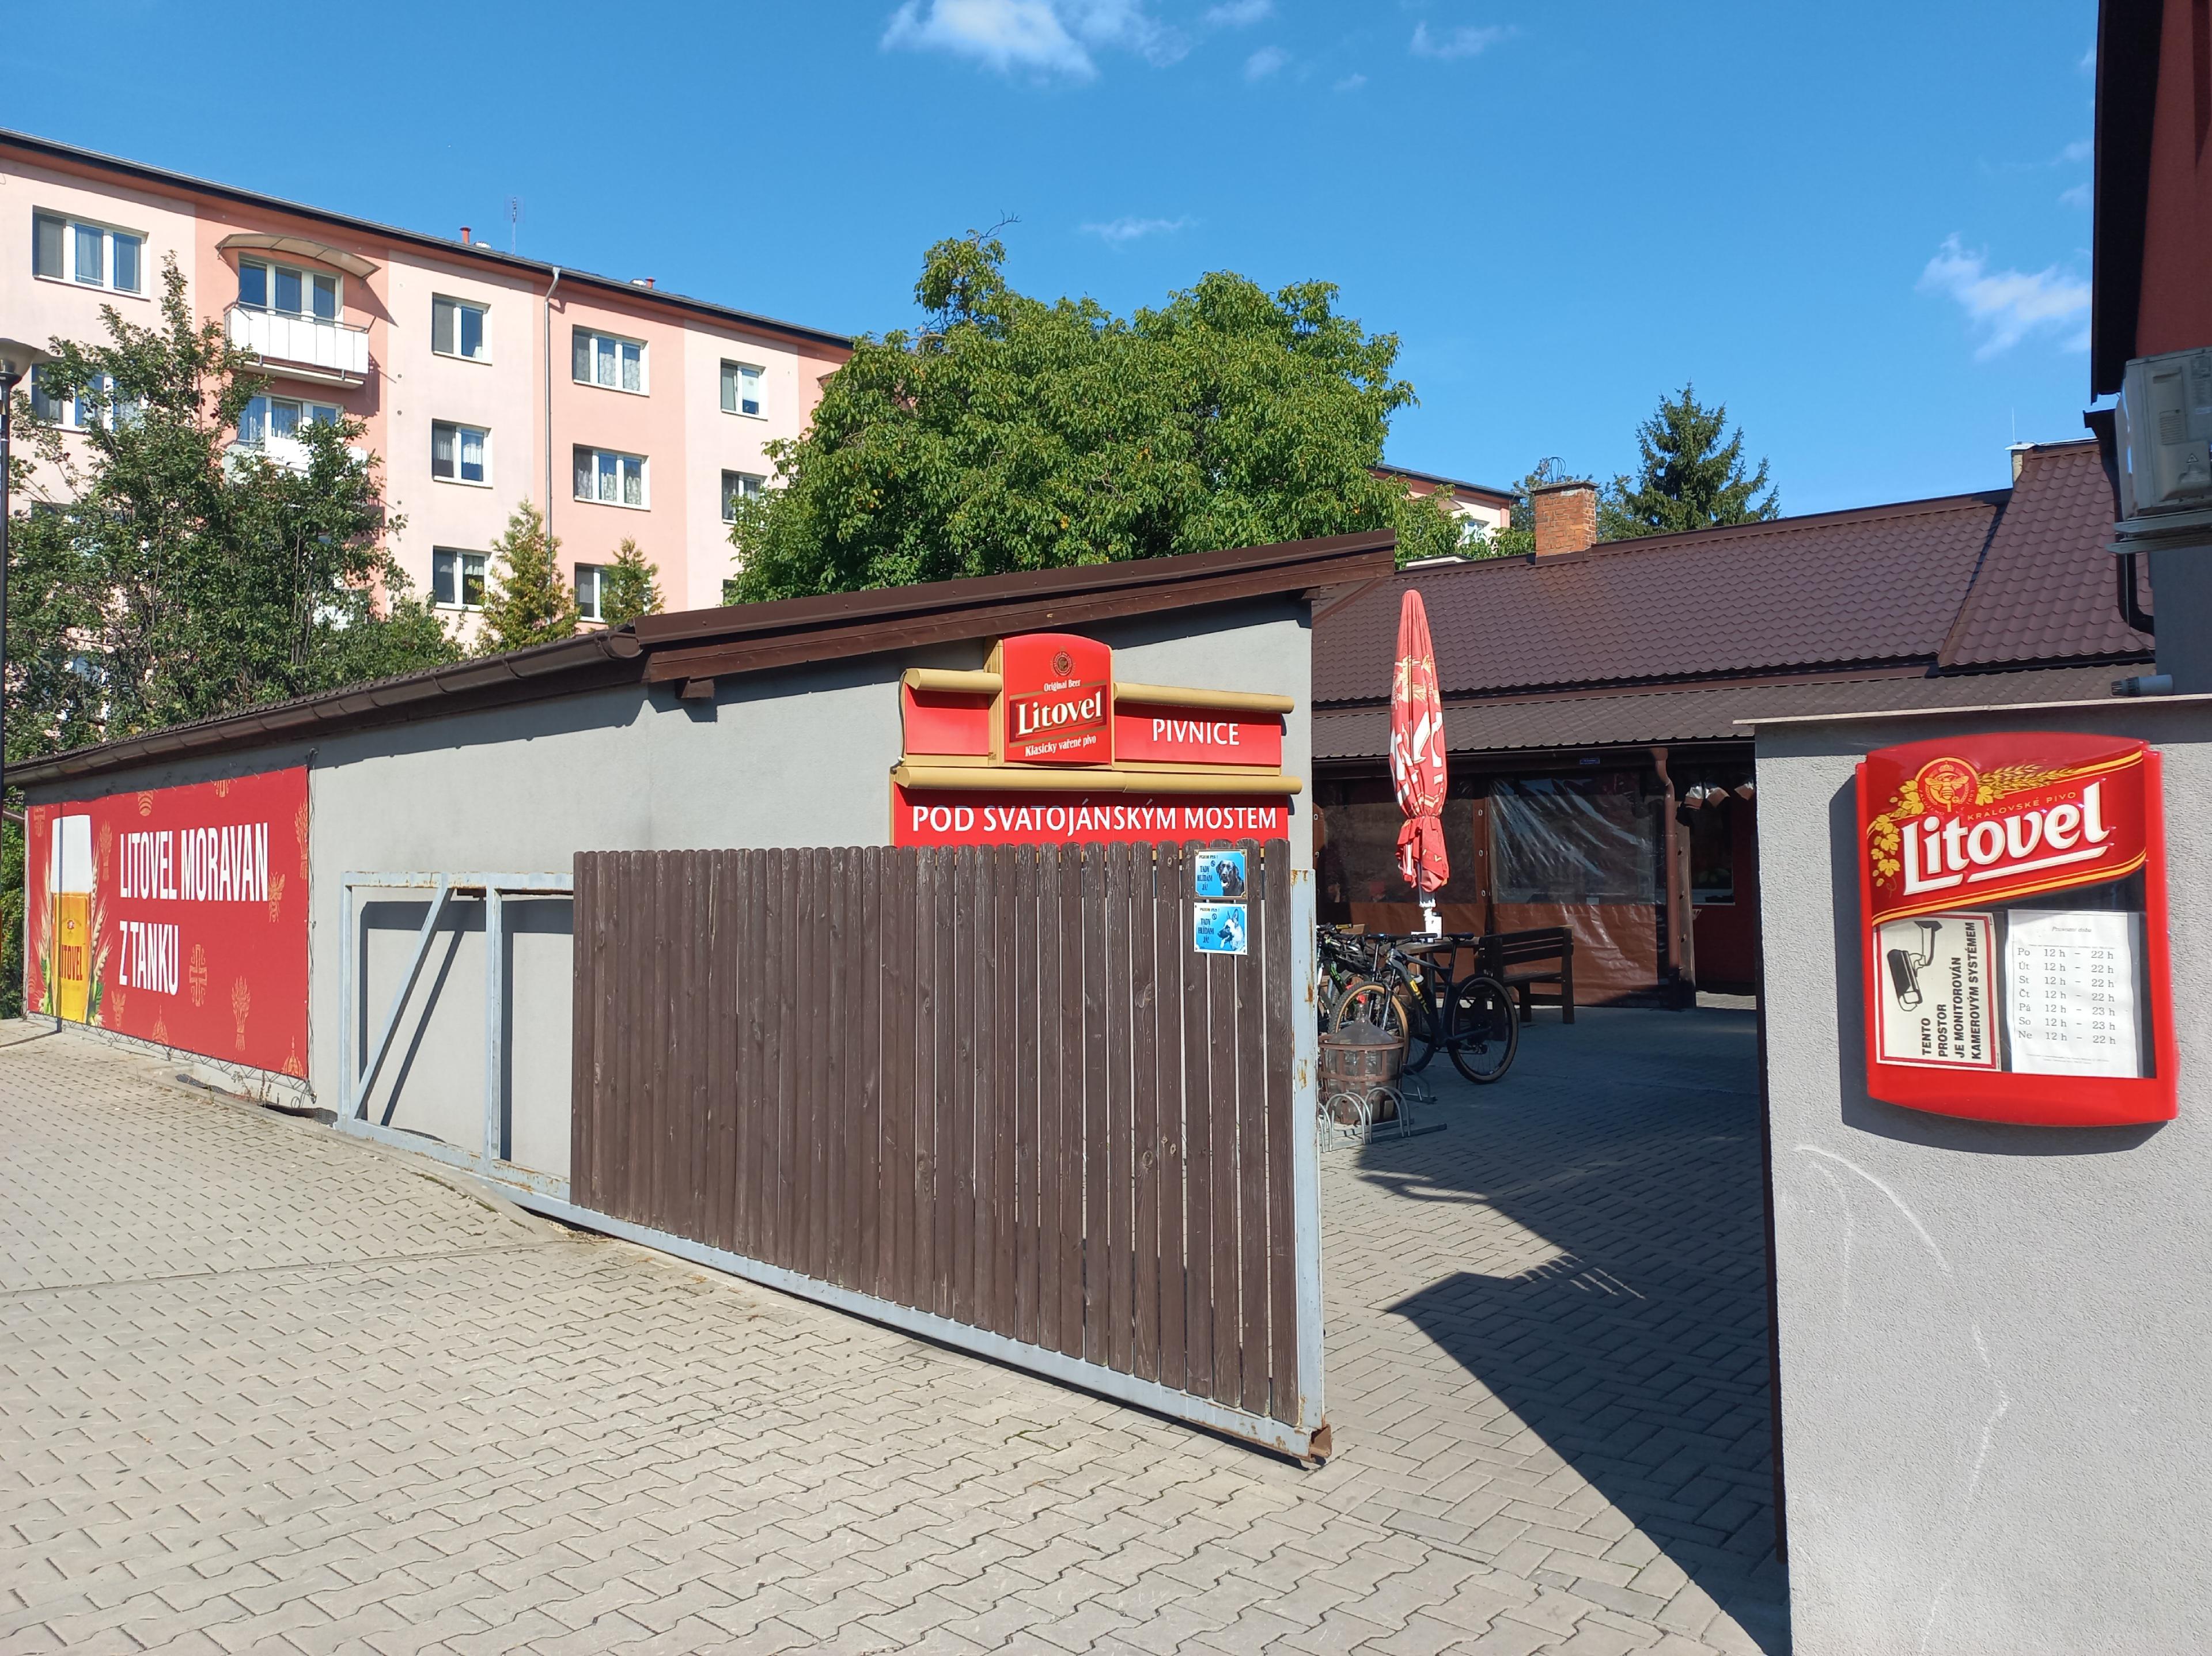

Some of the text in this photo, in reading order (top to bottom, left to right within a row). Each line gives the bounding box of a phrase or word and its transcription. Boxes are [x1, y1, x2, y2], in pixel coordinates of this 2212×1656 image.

[1044, 679, 1081, 692] Original Beer
[1017, 689, 1102, 737] Litovel
[1025, 734, 1097, 757] Klasicky vařené pivo
[1152, 718, 1240, 745] PIVNICE
[912, 798, 1278, 837] POD SVATOJÁNSKÝM MOSTEM
[1967, 797, 2040, 821] KRÁLOVSKÉ
[2046, 791, 2077, 805] PIVO
[1902, 780, 2110, 896] Litovel
[120, 823, 268, 902] LITOVEL MORAVAN
[119, 920, 179, 995] Z TANKU
[2017, 948, 2030, 956] Po
[2044, 949, 2055, 957] 12
[2091, 950, 2104, 959] 22
[2018, 961, 2030, 970] Út
[2044, 962, 2056, 971] 12
[2091, 965, 2104, 973] 22
[2108, 965, 2114, 973] h
[1964, 922, 1982, 1060] KAMEROVÝM SYSTÉMEM
[2018, 976, 2029, 984] St
[2044, 977, 2056, 985] 12
[2060, 977, 2066, 986] h
[2092, 979, 2104, 987] 22
[2108, 980, 2114, 988] h
[2019, 988, 2030, 998] Čt
[2045, 991, 2056, 999] 12
[2092, 993, 2104, 1001] 22
[1949, 957, 1965, 1058] JE MONITOROVÁN
[2019, 1003, 2031, 1011] Pá
[2045, 1004, 2056, 1013] 12
[2061, 1005, 2066, 1013] h
[2092, 1007, 2105, 1015] 23
[2109, 1008, 2115, 1016] h
[1921, 1018, 1931, 1055] TENTO
[1937, 1004, 1948, 1058] PROSTOR
[2018, 1017, 2031, 1025] So
[2046, 1018, 2057, 1026] 12
[2092, 1021, 2105, 1029] 23
[2018, 1030, 2032, 1039] Ne
[2046, 1032, 2057, 1040] 12
[2093, 1036, 2106, 1044] 22
[2109, 1036, 2116, 1044] h
